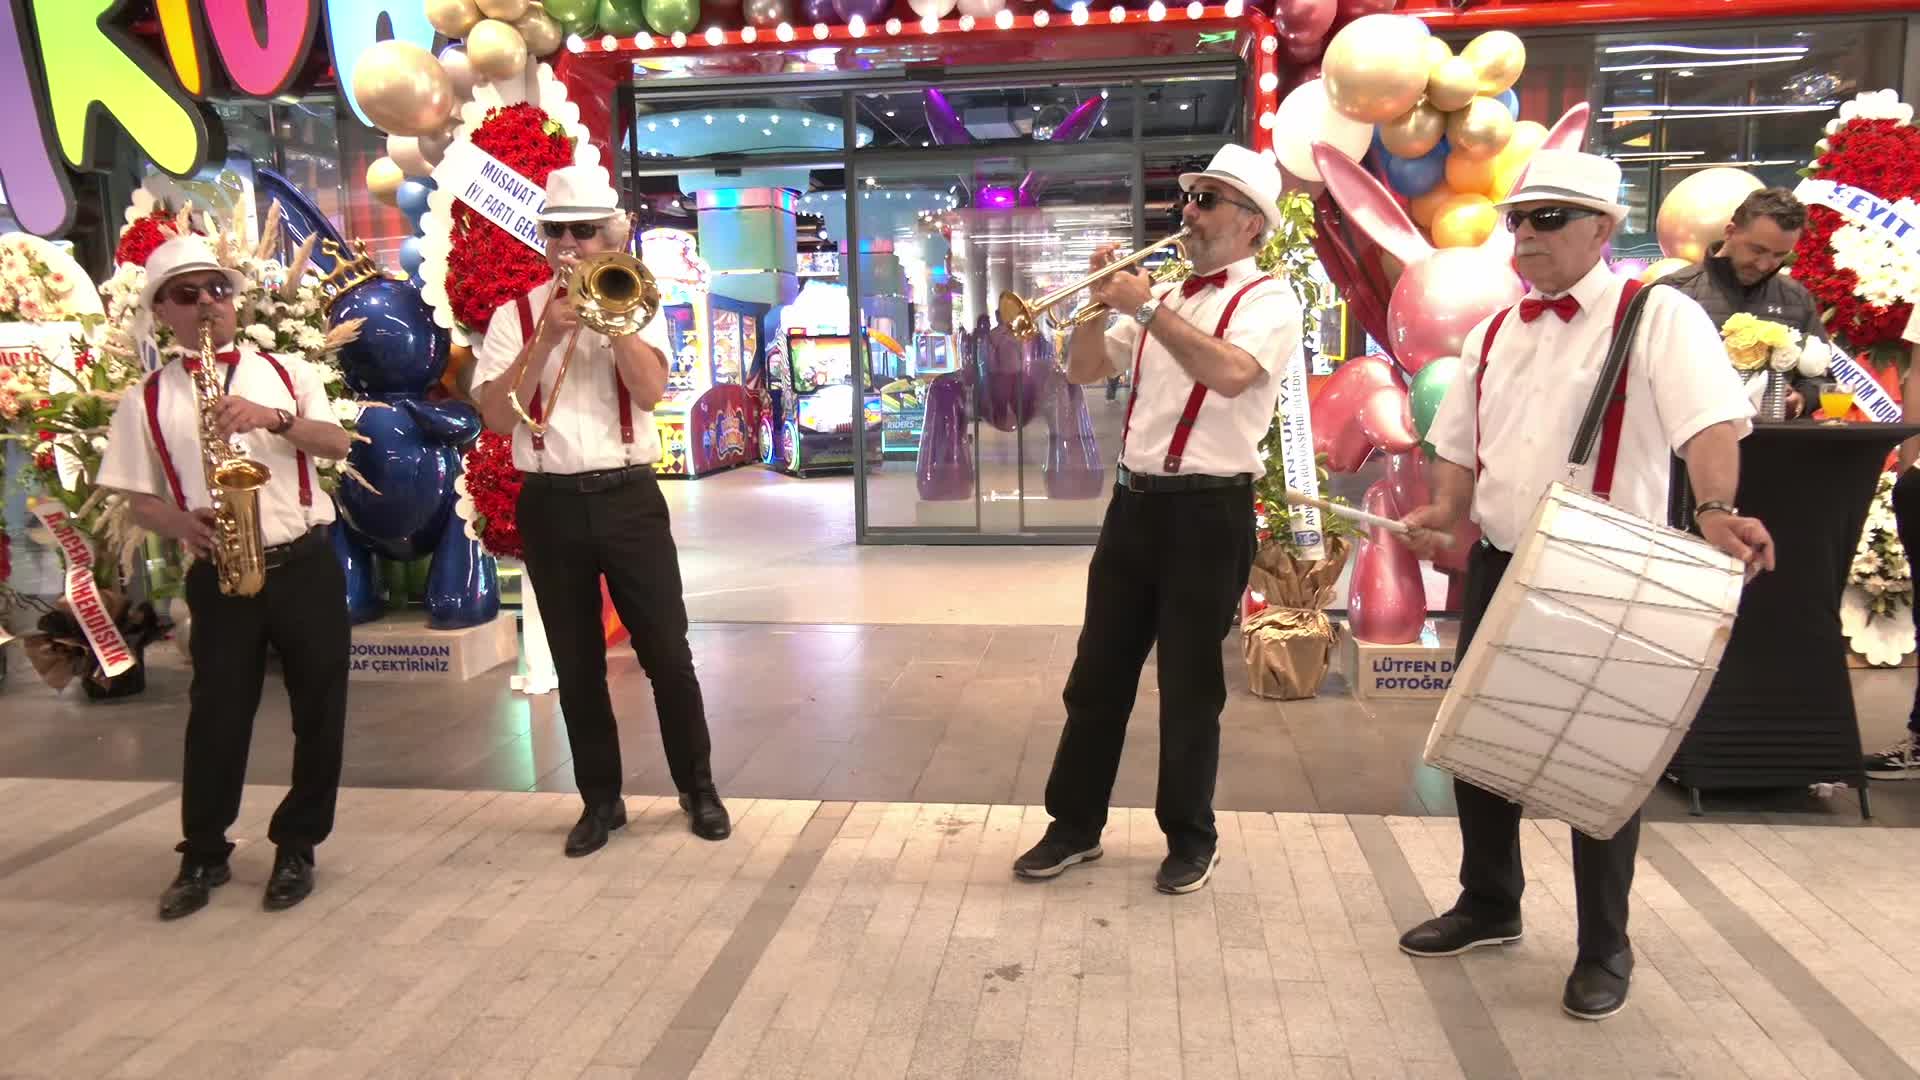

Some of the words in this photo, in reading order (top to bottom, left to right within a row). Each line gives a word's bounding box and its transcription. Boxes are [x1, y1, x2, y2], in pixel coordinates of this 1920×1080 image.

[1303, 482, 1315, 526] ANKRA
[349, 645, 450, 657] DOKUNMADAN
[349, 660, 369, 671] AF
[372, 657, 449, 673] ÇEKTİRİNİZ
[1373, 656, 1436, 672] LÜTFEN
